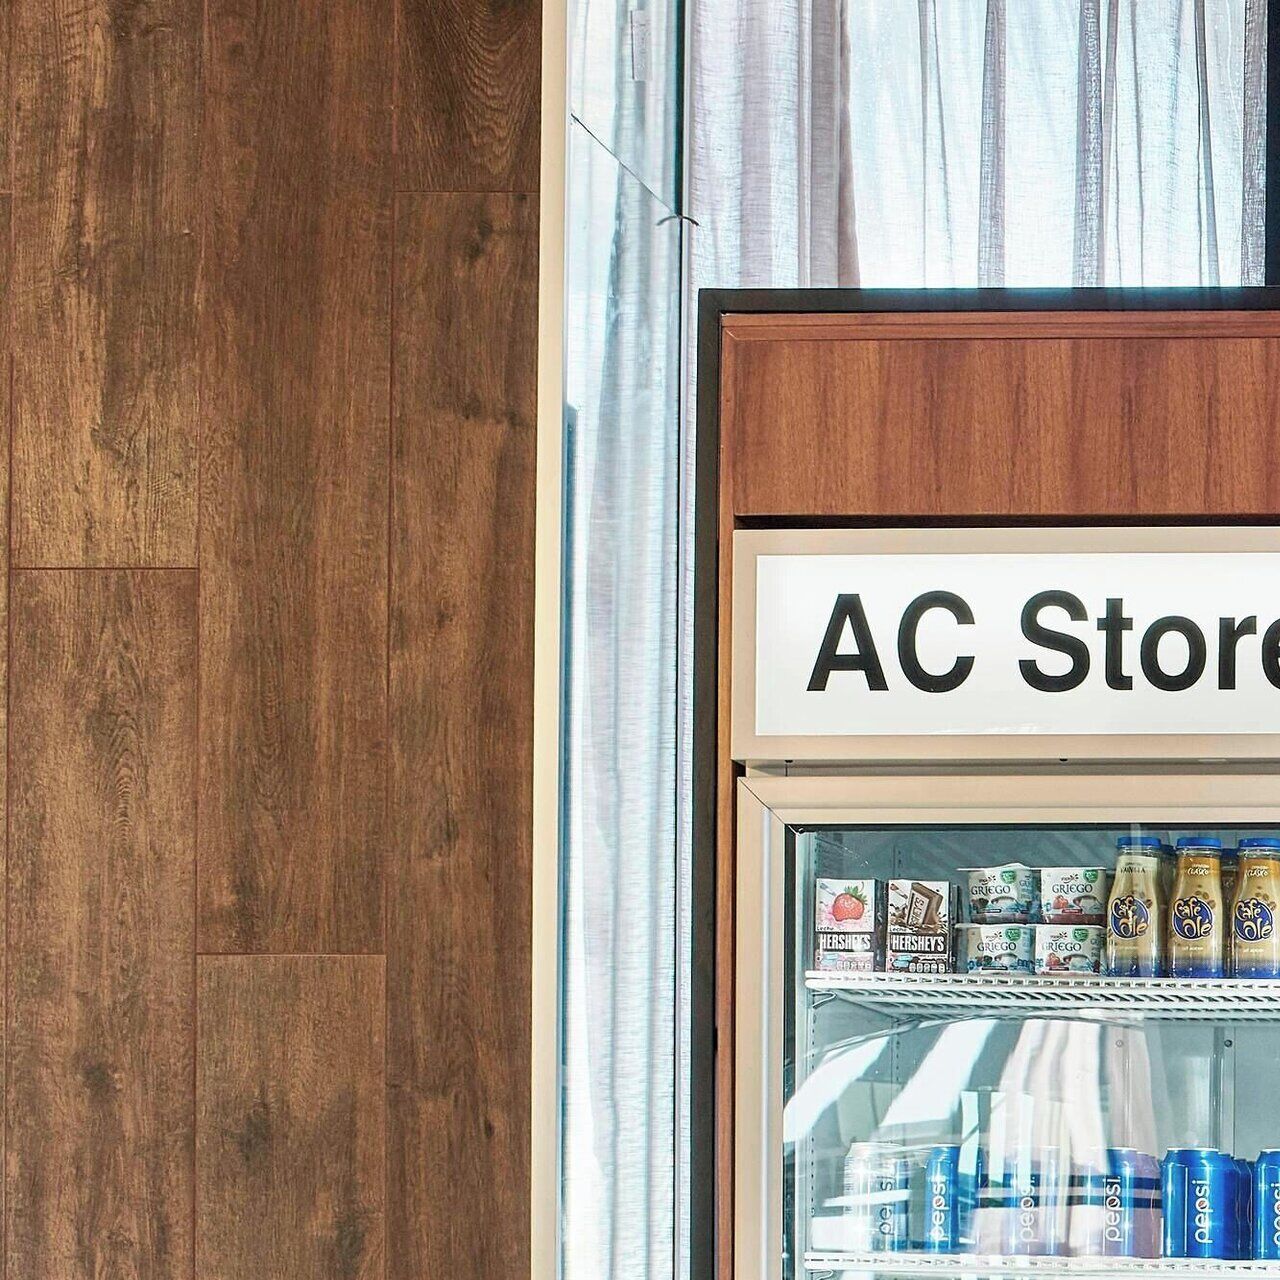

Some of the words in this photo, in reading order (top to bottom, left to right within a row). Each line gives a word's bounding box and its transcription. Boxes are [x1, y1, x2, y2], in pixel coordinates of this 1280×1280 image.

[806, 590, 975, 693] AC
[971, 884, 1011, 896] GRIEGO
[1052, 883, 1093, 895] GRIEGO
[1235, 898, 1261, 921] Café
[1182, 916, 1212, 938] Olé
[1243, 918, 1273, 939] Olé
[892, 935, 945, 952] HERSHEY'S
[977, 942, 1017, 953] GRIEGO
[1103, 1177, 1123, 1242] pepsi
[1192, 1179, 1213, 1244] pepsi
